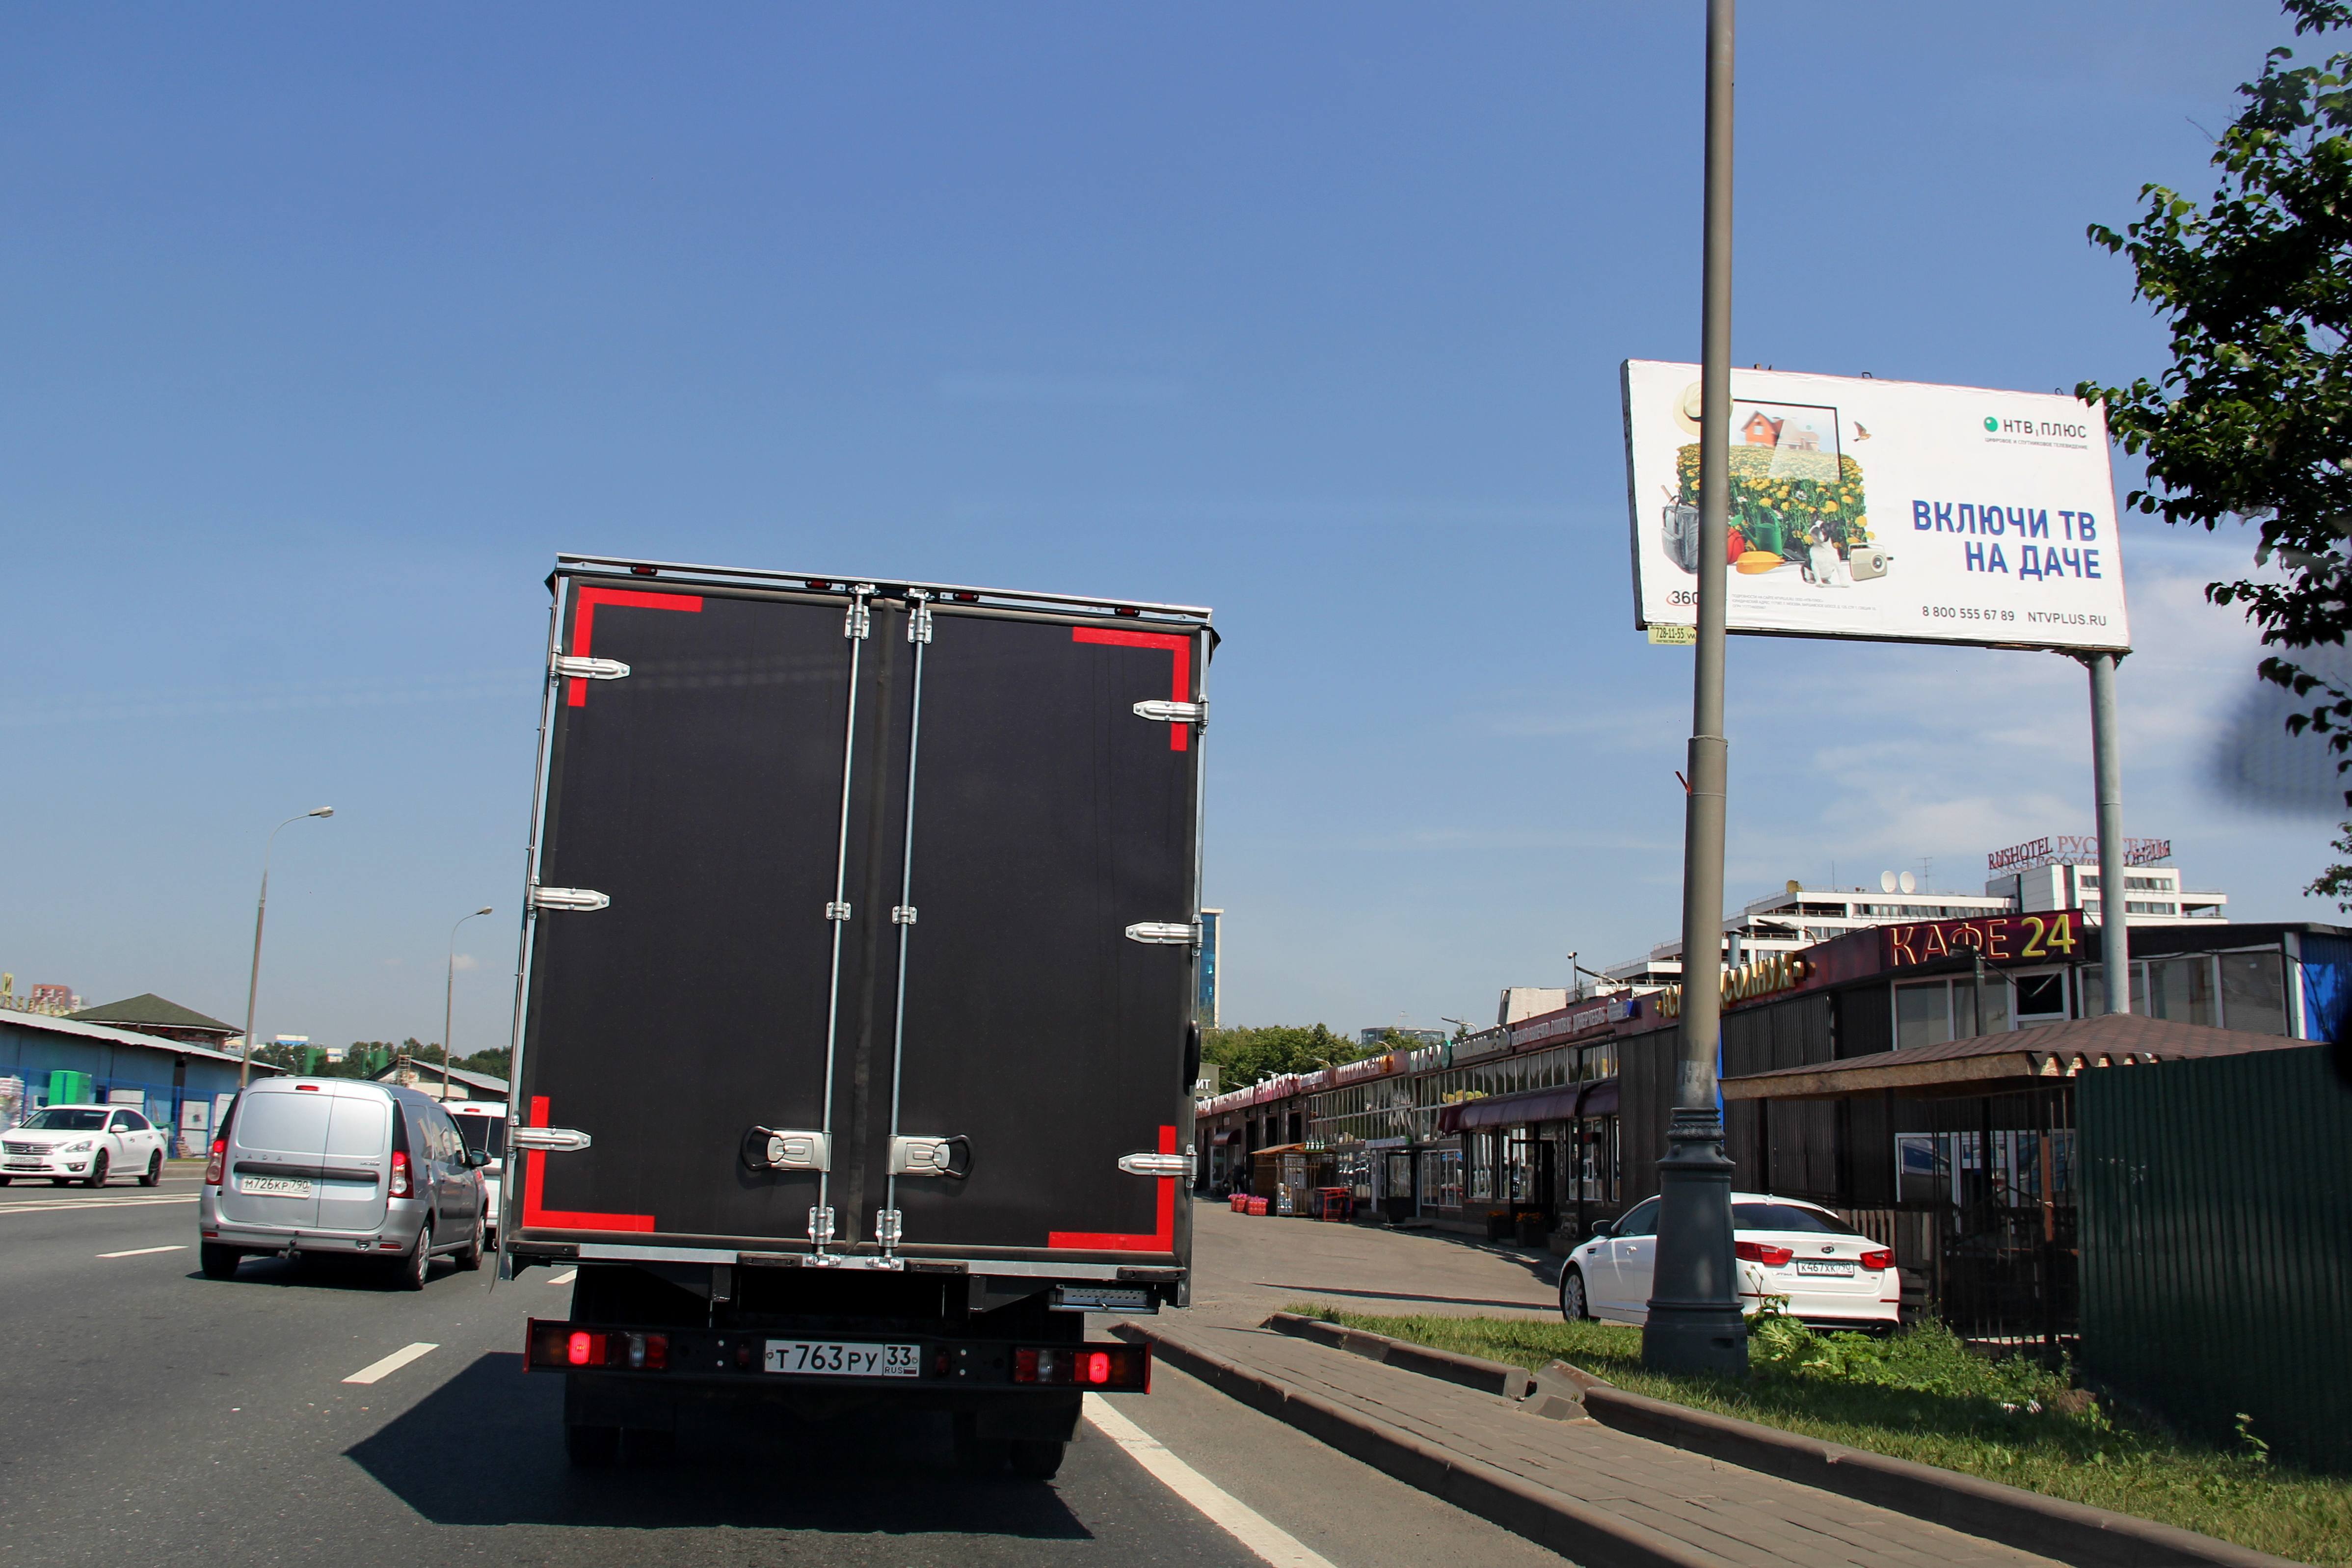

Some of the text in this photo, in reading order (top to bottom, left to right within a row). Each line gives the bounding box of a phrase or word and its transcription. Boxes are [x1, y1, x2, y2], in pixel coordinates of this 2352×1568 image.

[1912, 500, 2096, 541] ВКЛЮЧИ ТВ
[1964, 541, 2102, 582] НА ДАЧЕ
[1922, 606, 2107, 626] 8 800 555 67 89 NTVPLUS.RU
[1656, 627, 1684, 638] 728-11-55
[1987, 837, 2053, 869] RUSHOTEL
[1890, 914, 2076, 966] КАФЕ 24
[235, 1153, 283, 1162] LADA
[1801, 1260, 1835, 1273] К467ХК
[776, 1344, 911, 1372] Т763РУ 33
